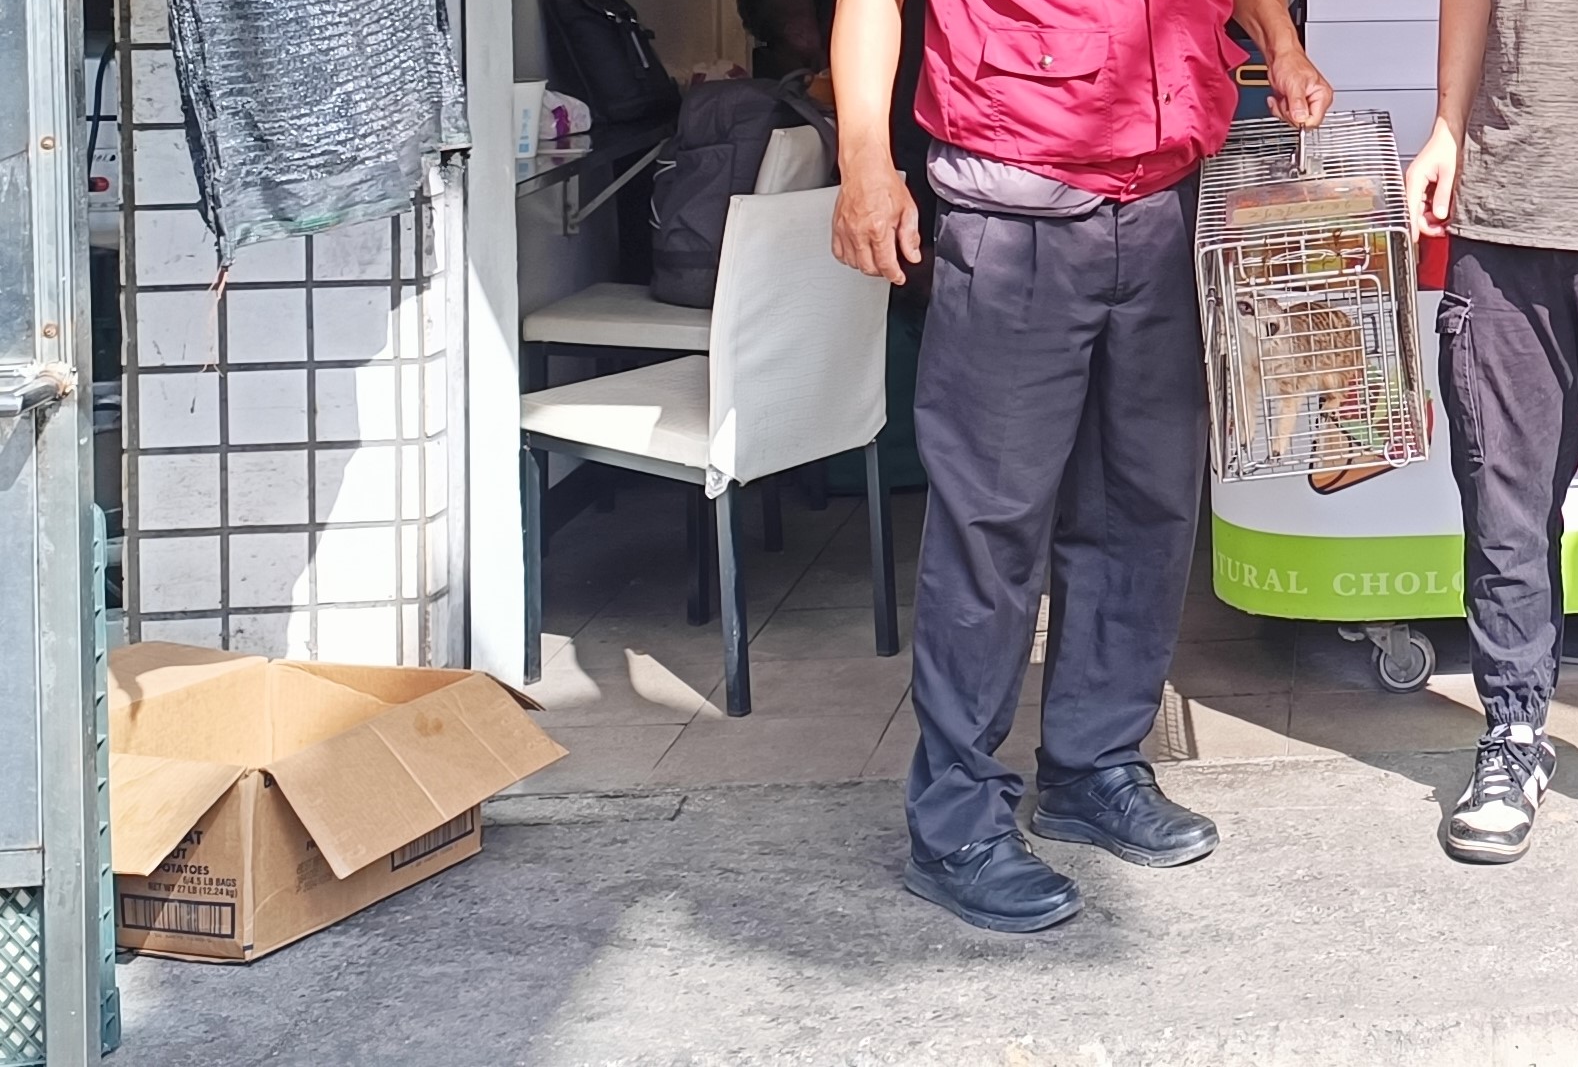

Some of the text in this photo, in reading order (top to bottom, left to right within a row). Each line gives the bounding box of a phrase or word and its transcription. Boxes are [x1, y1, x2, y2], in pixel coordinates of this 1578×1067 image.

[1216, 551, 1309, 595] TURAL
[182, 830, 204, 846] AT
[216, 878, 237, 888] BAGS
